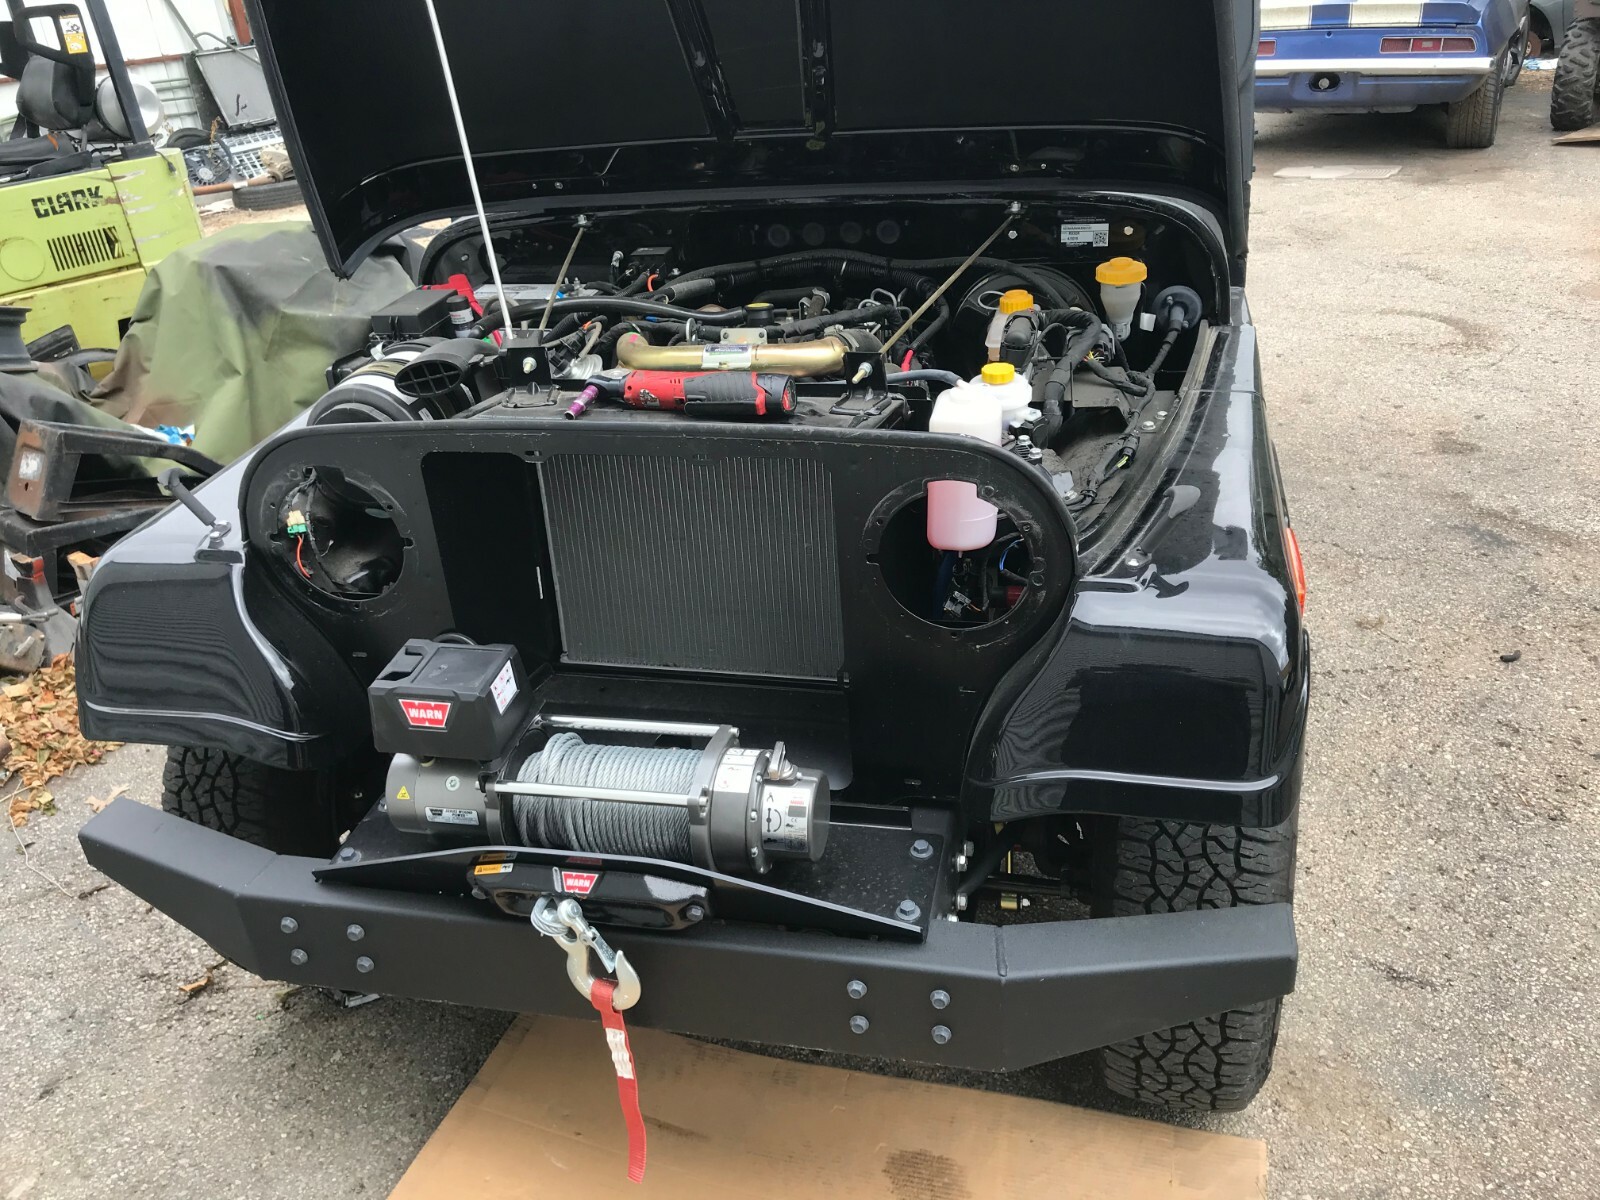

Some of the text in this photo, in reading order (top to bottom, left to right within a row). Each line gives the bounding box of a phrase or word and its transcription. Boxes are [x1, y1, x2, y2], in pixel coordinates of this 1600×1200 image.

[31, 186, 103, 218] CLARK
[408, 708, 442, 719] WARN
[566, 878, 591, 887] WARN
